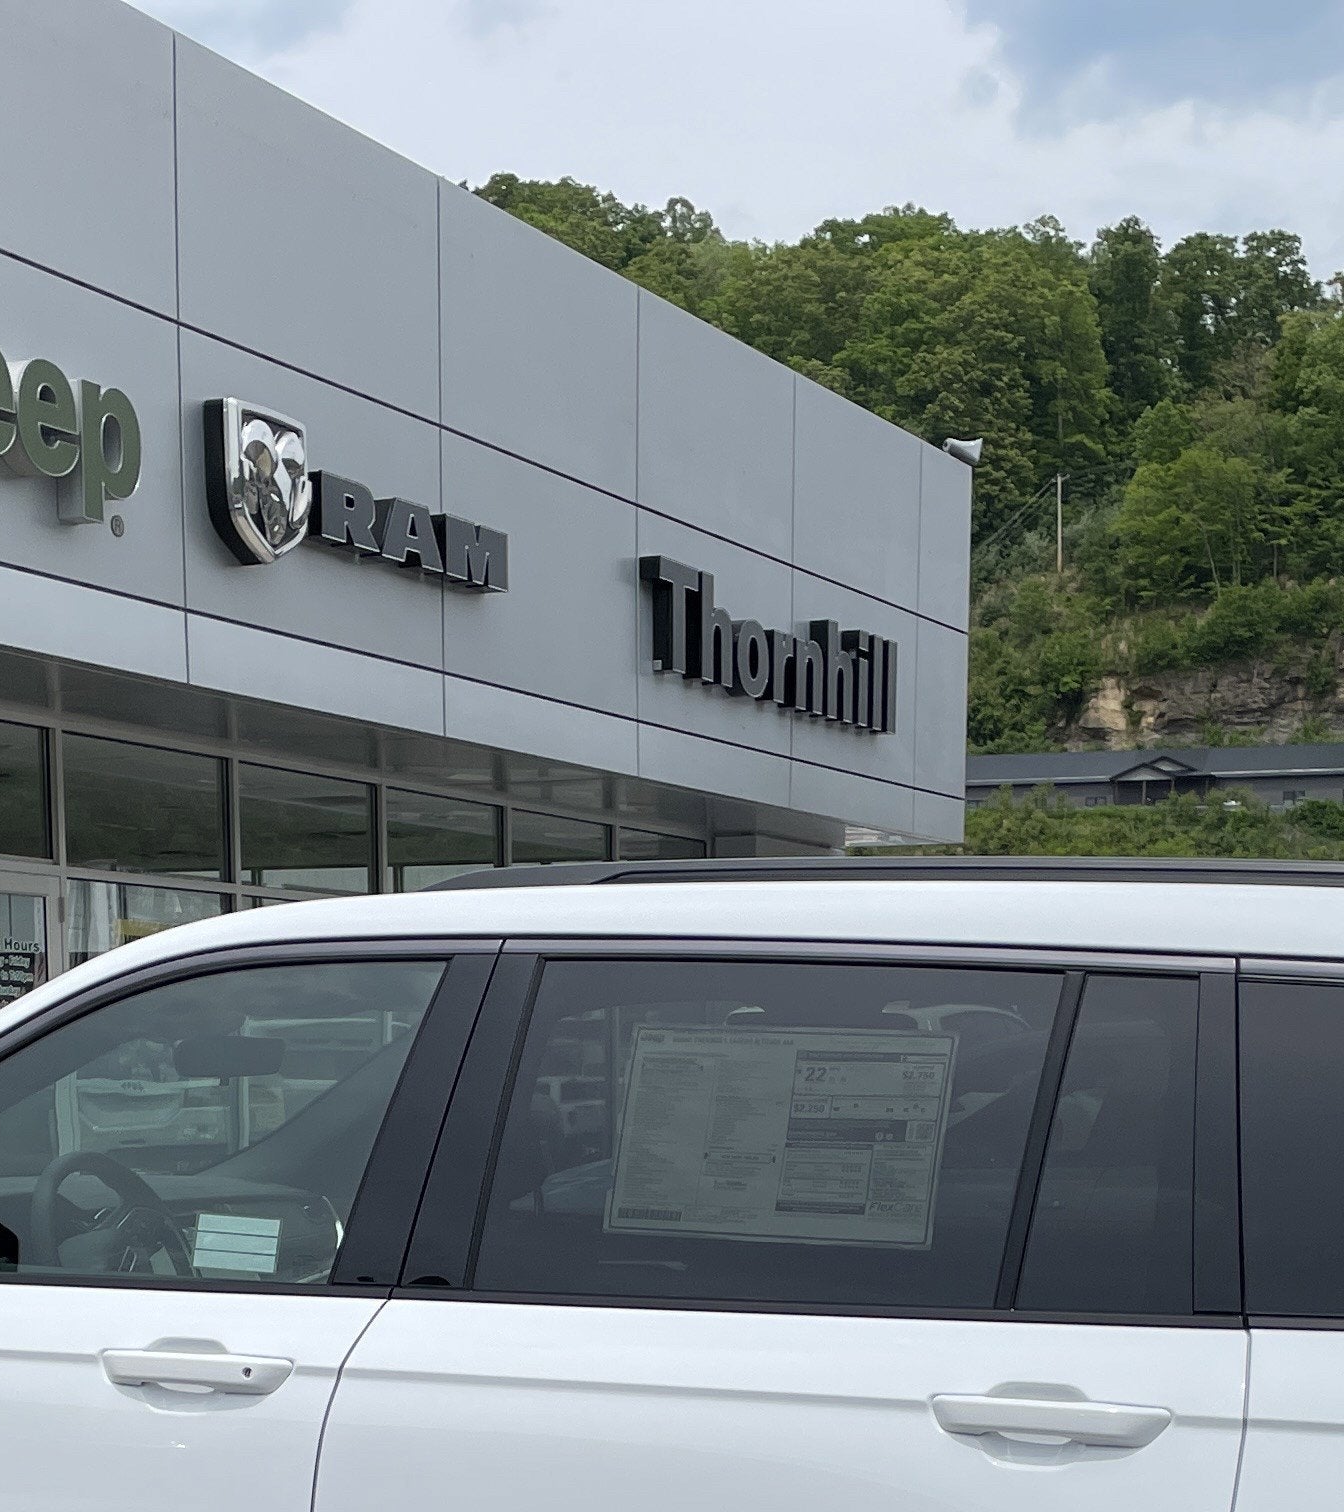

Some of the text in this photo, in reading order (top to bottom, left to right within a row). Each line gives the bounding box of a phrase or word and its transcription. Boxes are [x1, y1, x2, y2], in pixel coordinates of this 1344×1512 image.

[319, 469, 509, 592] RAM
[658, 554, 898, 734] Thornhill
[4, 938, 41, 953] Hours
[805, 1066, 828, 1082] 22
